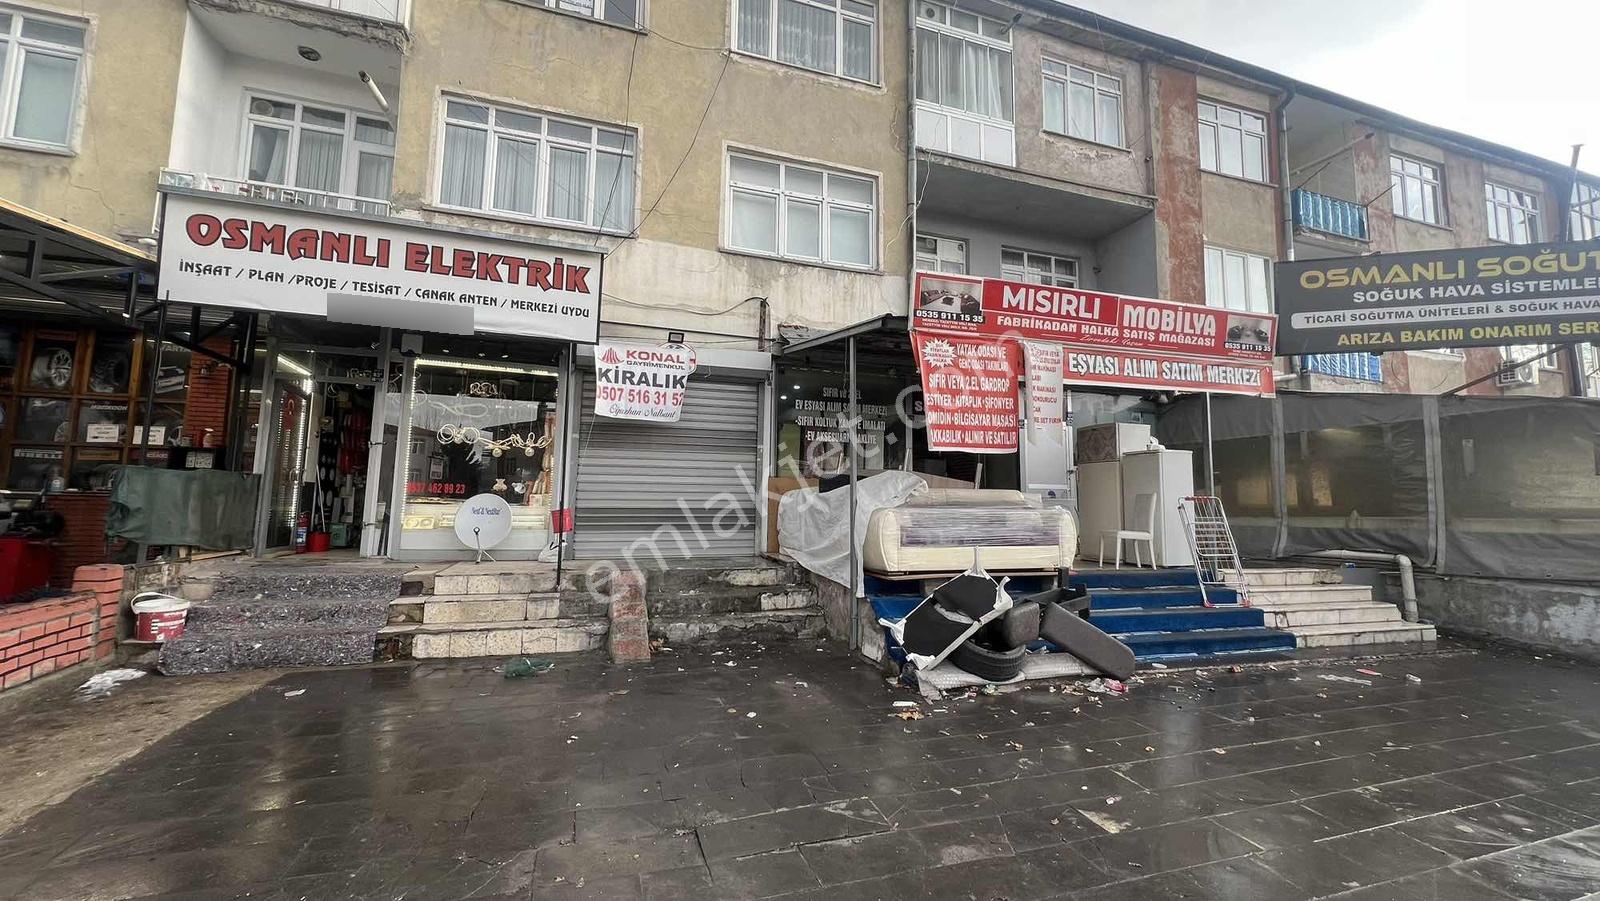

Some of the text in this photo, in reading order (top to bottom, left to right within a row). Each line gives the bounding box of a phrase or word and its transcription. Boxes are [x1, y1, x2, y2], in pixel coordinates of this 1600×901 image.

[185, 214, 591, 294] OSMANLI ELEKTRİK
[1300, 259, 1465, 289] OSMANLI
[178, 258, 232, 277] İNŞAAT
[248, 268, 285, 283] PLAN
[351, 281, 402, 296] TESİSAT
[459, 293, 498, 307] ANTEN
[511, 299, 558, 314] MERKEZİ
[561, 306, 591, 319] UYDU
[1353, 287, 1424, 303] SOĞUK
[1430, 284, 1485, 298] HAVA
[916, 310, 983, 323] 0535 911 15 35
[1002, 285, 1216, 337] MISIRLI MOBİLYA
[1304, 313, 1346, 324] TİCARİ
[1350, 310, 1414, 322] SOĞUTMA
[1418, 304, 1489, 318] ÜNİTELERİ
[1508, 302, 1558, 313] SOĞUK
[1563, 299, 1600, 311] HAVA
[997, 315, 1215, 348] FABRİKADAN HALKA SATIŞ MAĞAZASI
[1337, 332, 1395, 346] ARIZA
[1400, 327, 1464, 343] BAKIM
[1470, 323, 1552, 340] ONARIM
[626, 350, 685, 364] KONAL
[956, 343, 977, 356] YATAK
[598, 366, 687, 389] KİRALIK
[1068, 352, 1119, 376] EŞYASI
[1124, 357, 1158, 379] ALIM
[1162, 361, 1206, 382] SATIM
[1207, 365, 1261, 386] MERKEZİ
[929, 373, 946, 388] SIFIR
[947, 374, 964, 390] VEYA
[628, 388, 650, 404] 516
[654, 391, 667, 405] 31
[955, 393, 982, 408] KİTAPLIK
[985, 395, 1014, 411] ŞİFONYER
[953, 410, 991, 427] BİLGİSAYAR
[455, 483, 466, 494] 23
